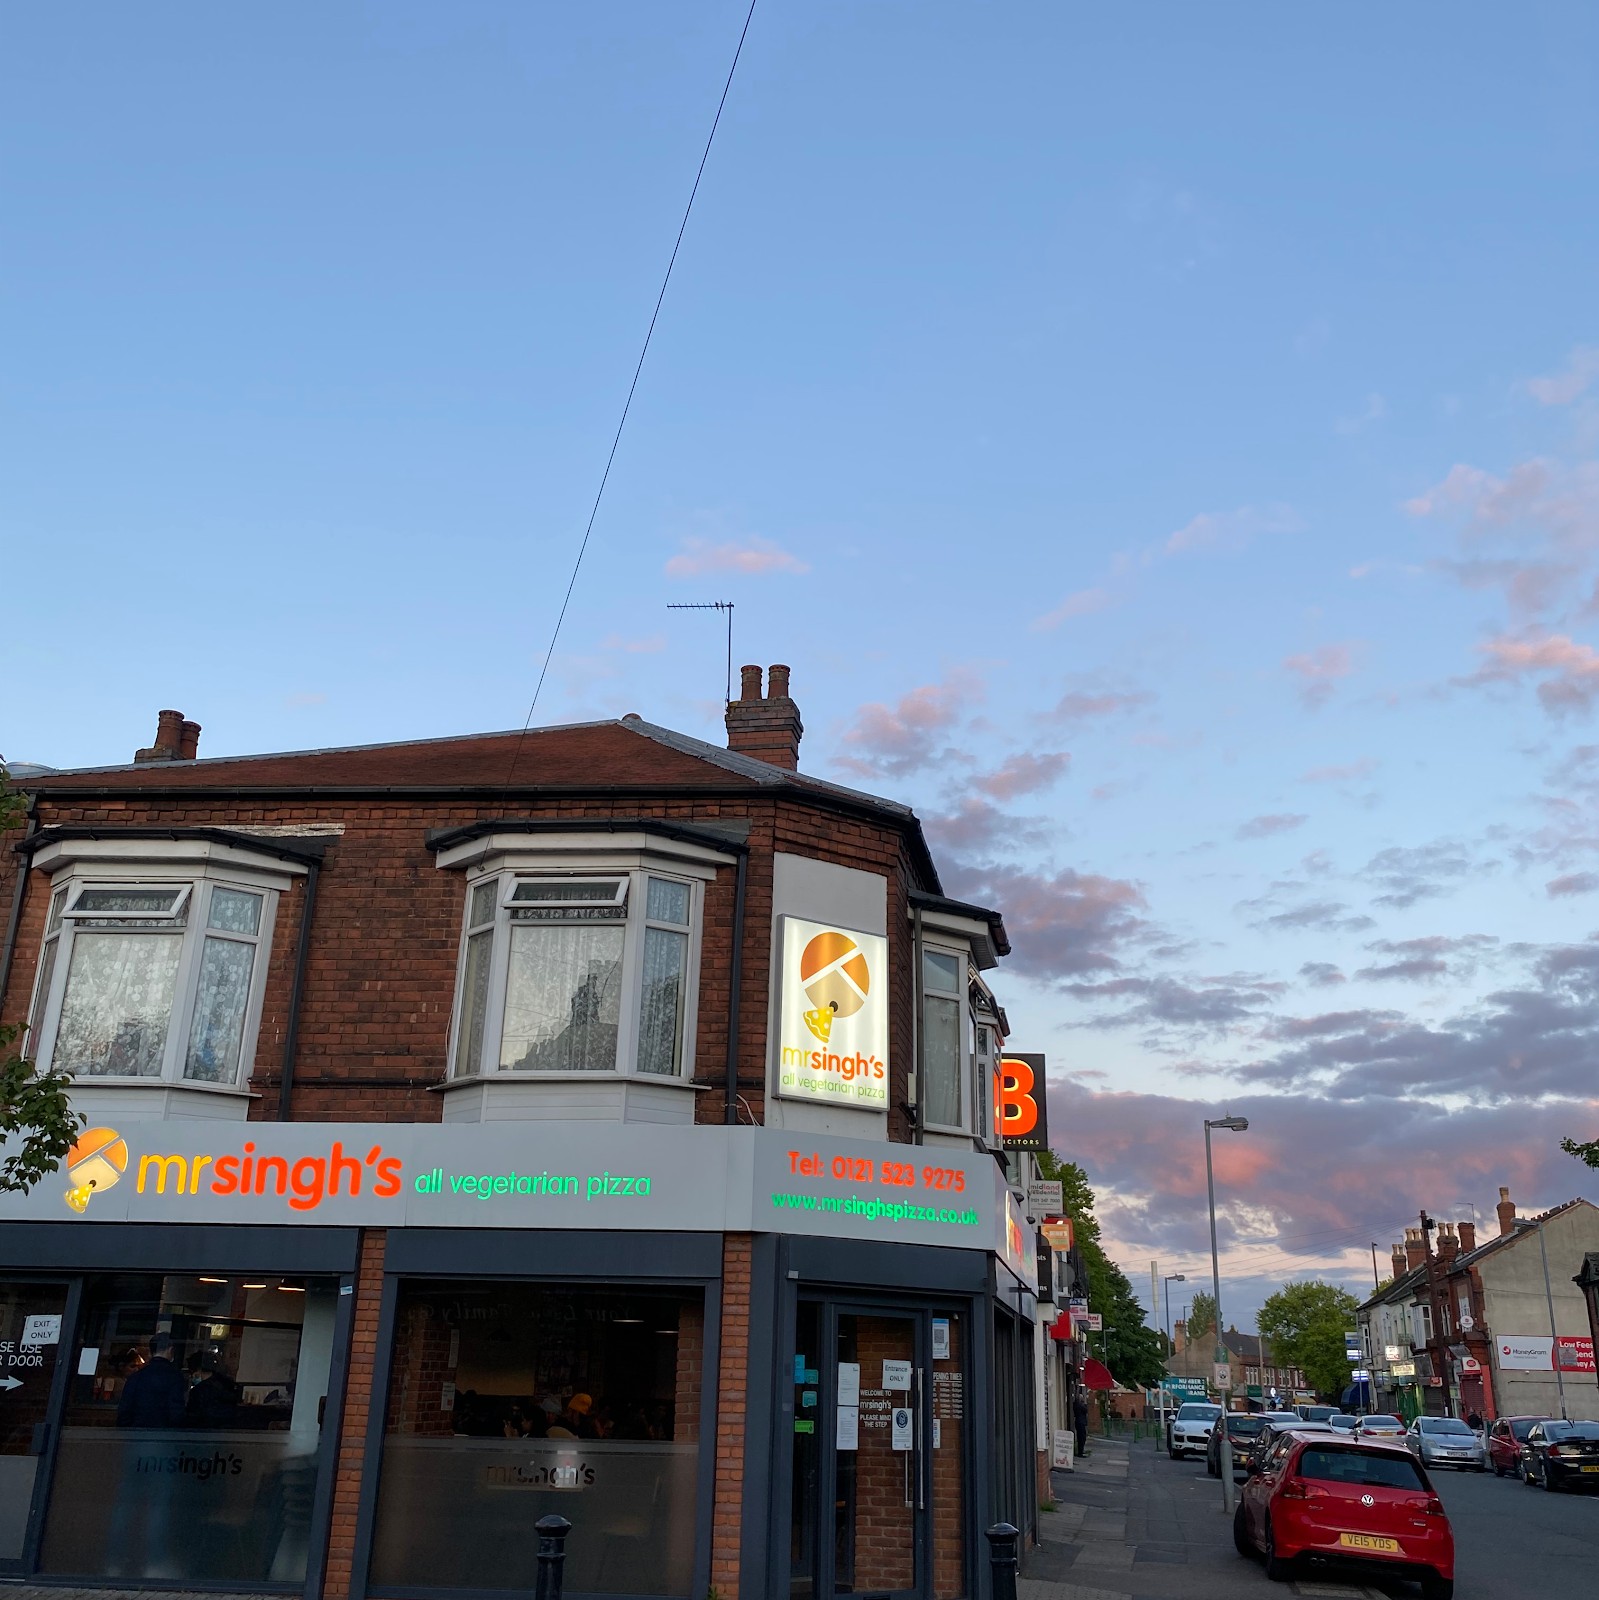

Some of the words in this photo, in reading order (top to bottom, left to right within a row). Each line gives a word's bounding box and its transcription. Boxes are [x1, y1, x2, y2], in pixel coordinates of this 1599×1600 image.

[783, 1047, 884, 1081] mrsingh's
[782, 1073, 795, 1085] all
[798, 1077, 854, 1094] vegetarian
[858, 1085, 885, 1099] pizza
[137, 1142, 403, 1210] mrsingh's
[414, 1168, 443, 1193] all
[450, 1171, 579, 1200] vegetarian
[588, 1172, 650, 1200] pizza
[788, 1151, 824, 1177] Tel:
[832, 1156, 874, 1182] 0121
[880, 1162, 915, 1187] 523
[922, 1166, 965, 1192] 9275
[771, 1193, 979, 1225] www.mrsinghspizza.co.uk
[8, 1355, 43, 1367] DOOR
[860, 1399, 892, 1411] mrsingh's
[1348, 1535, 1370, 1546] VE15
[1373, 1538, 1392, 1549] YDS
